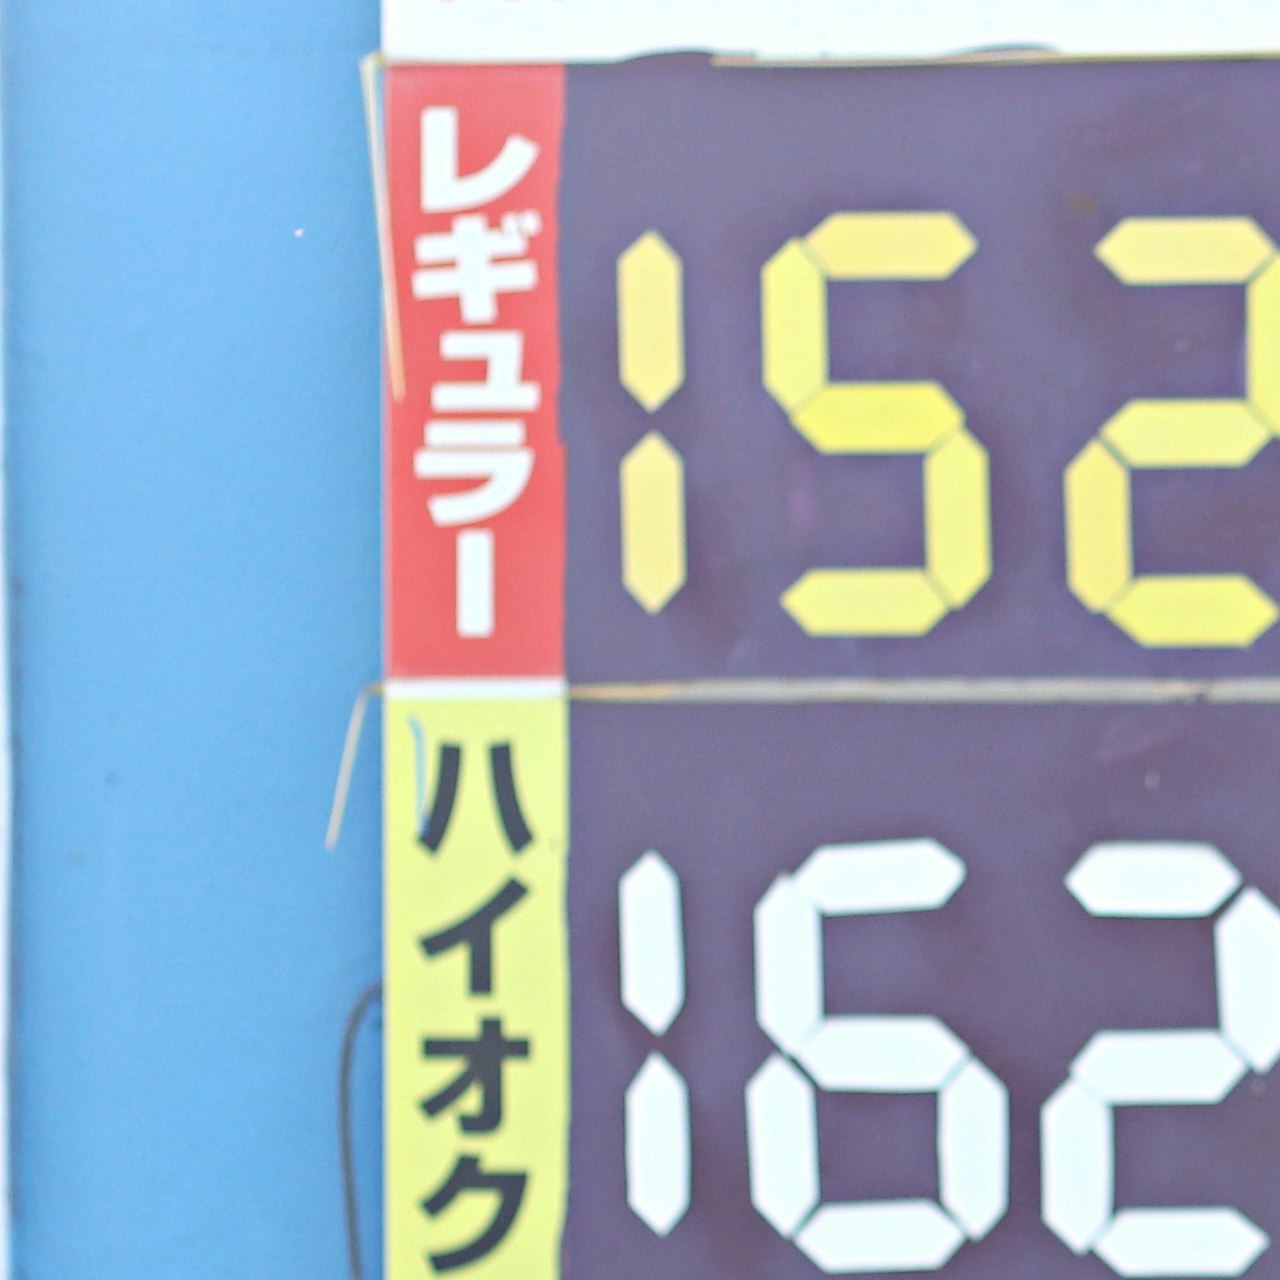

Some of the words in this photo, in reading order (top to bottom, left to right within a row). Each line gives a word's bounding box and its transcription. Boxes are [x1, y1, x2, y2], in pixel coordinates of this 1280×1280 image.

[412, 106, 542, 638] レギュラー
[415, 740, 534, 1276] ハイオク
